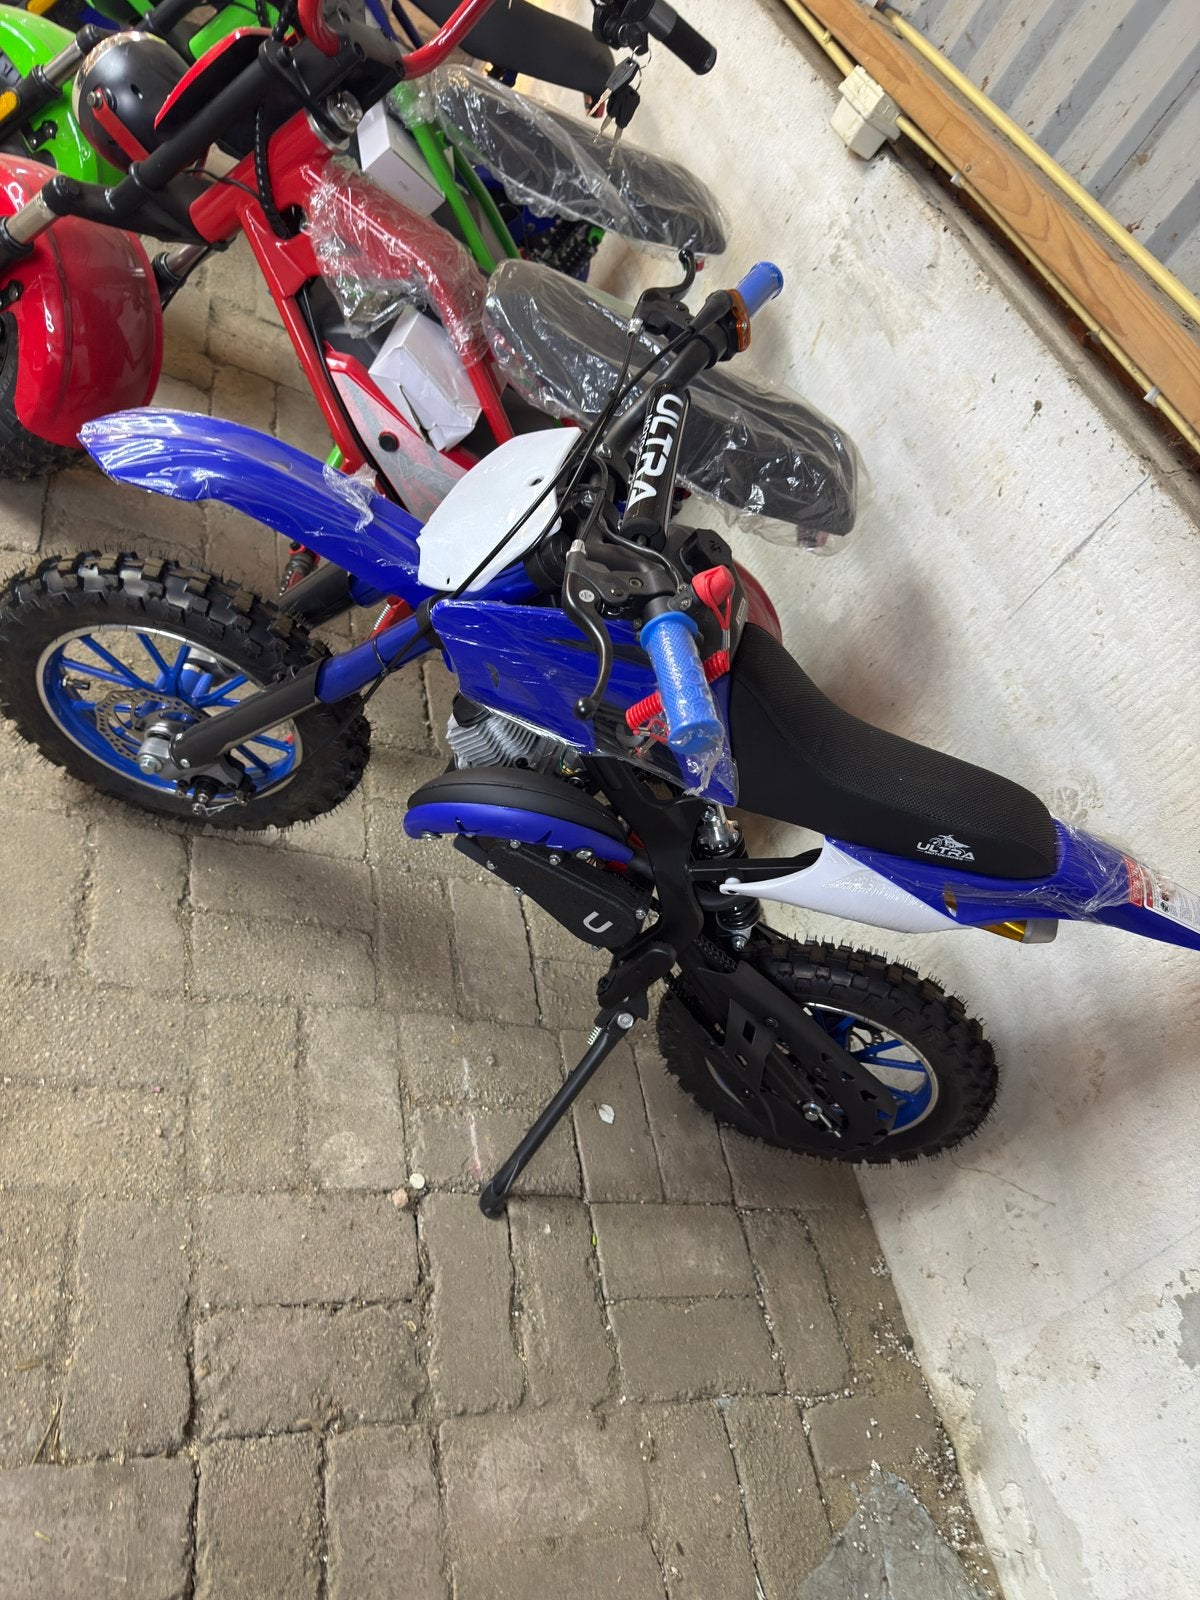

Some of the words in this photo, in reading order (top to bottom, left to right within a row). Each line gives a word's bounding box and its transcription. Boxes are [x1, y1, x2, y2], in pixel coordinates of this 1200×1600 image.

[627, 393, 684, 511] ULTRA
[916, 841, 975, 861] ULTRA
[583, 911, 614, 933] U
